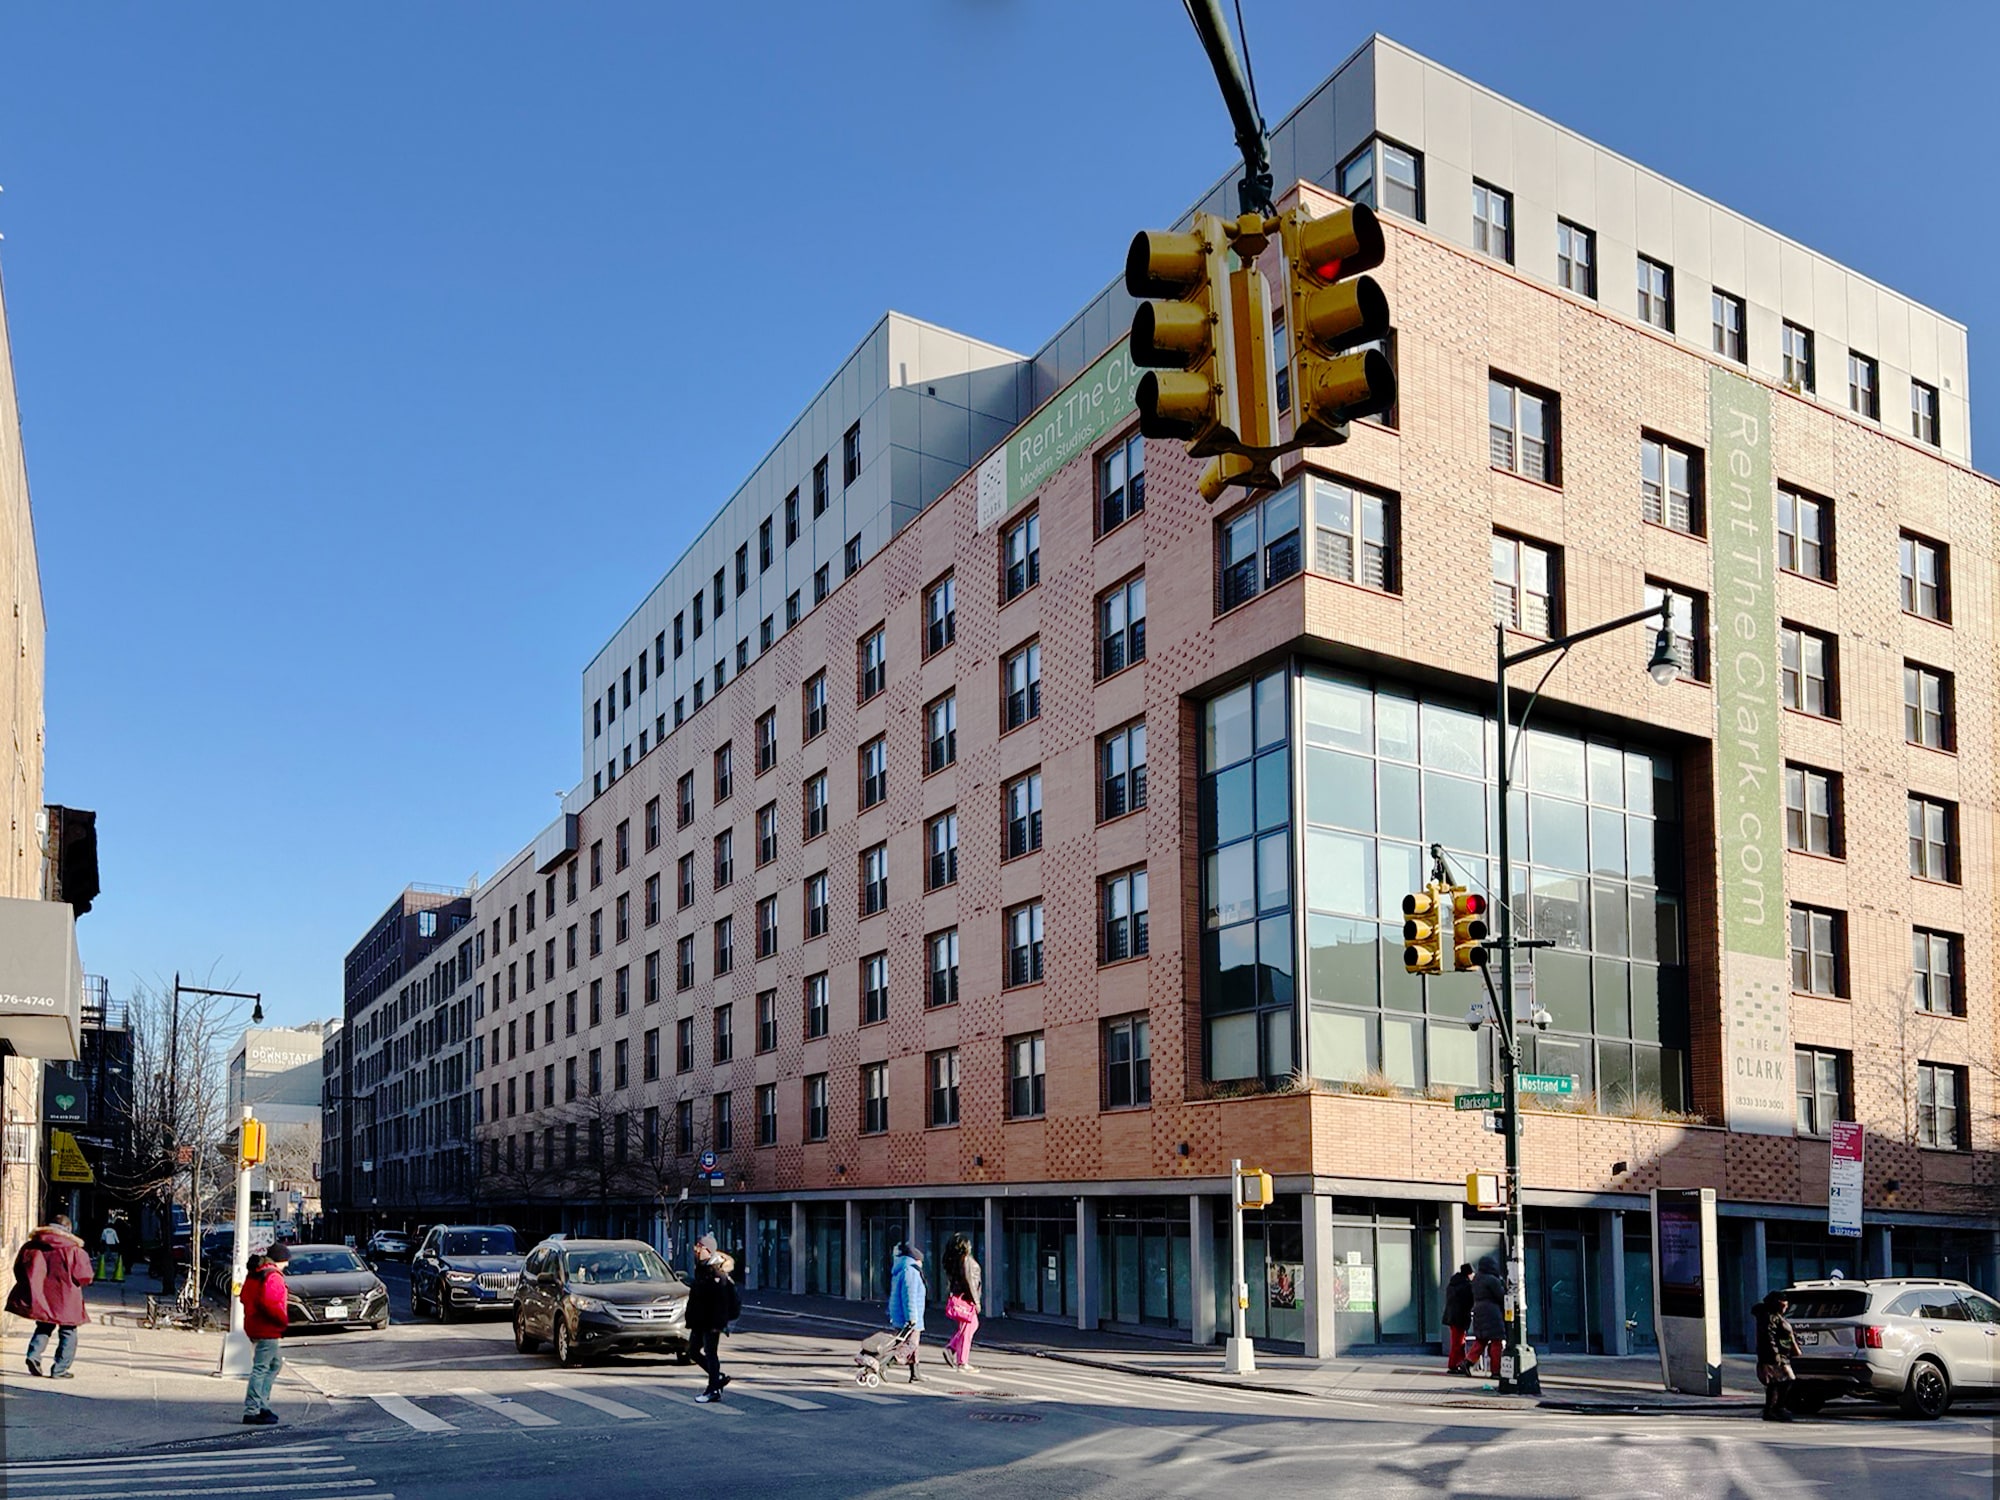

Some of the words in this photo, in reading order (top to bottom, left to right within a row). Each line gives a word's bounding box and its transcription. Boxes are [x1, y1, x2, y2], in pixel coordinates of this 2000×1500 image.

[1020, 456, 1053, 490] Modern
[1750, 1038, 1769, 1051] THE
[1736, 1056, 1783, 1080] CLARK
[1521, 1077, 1559, 1092] Nostrand
[1459, 1097, 1490, 1110] Clarkson
